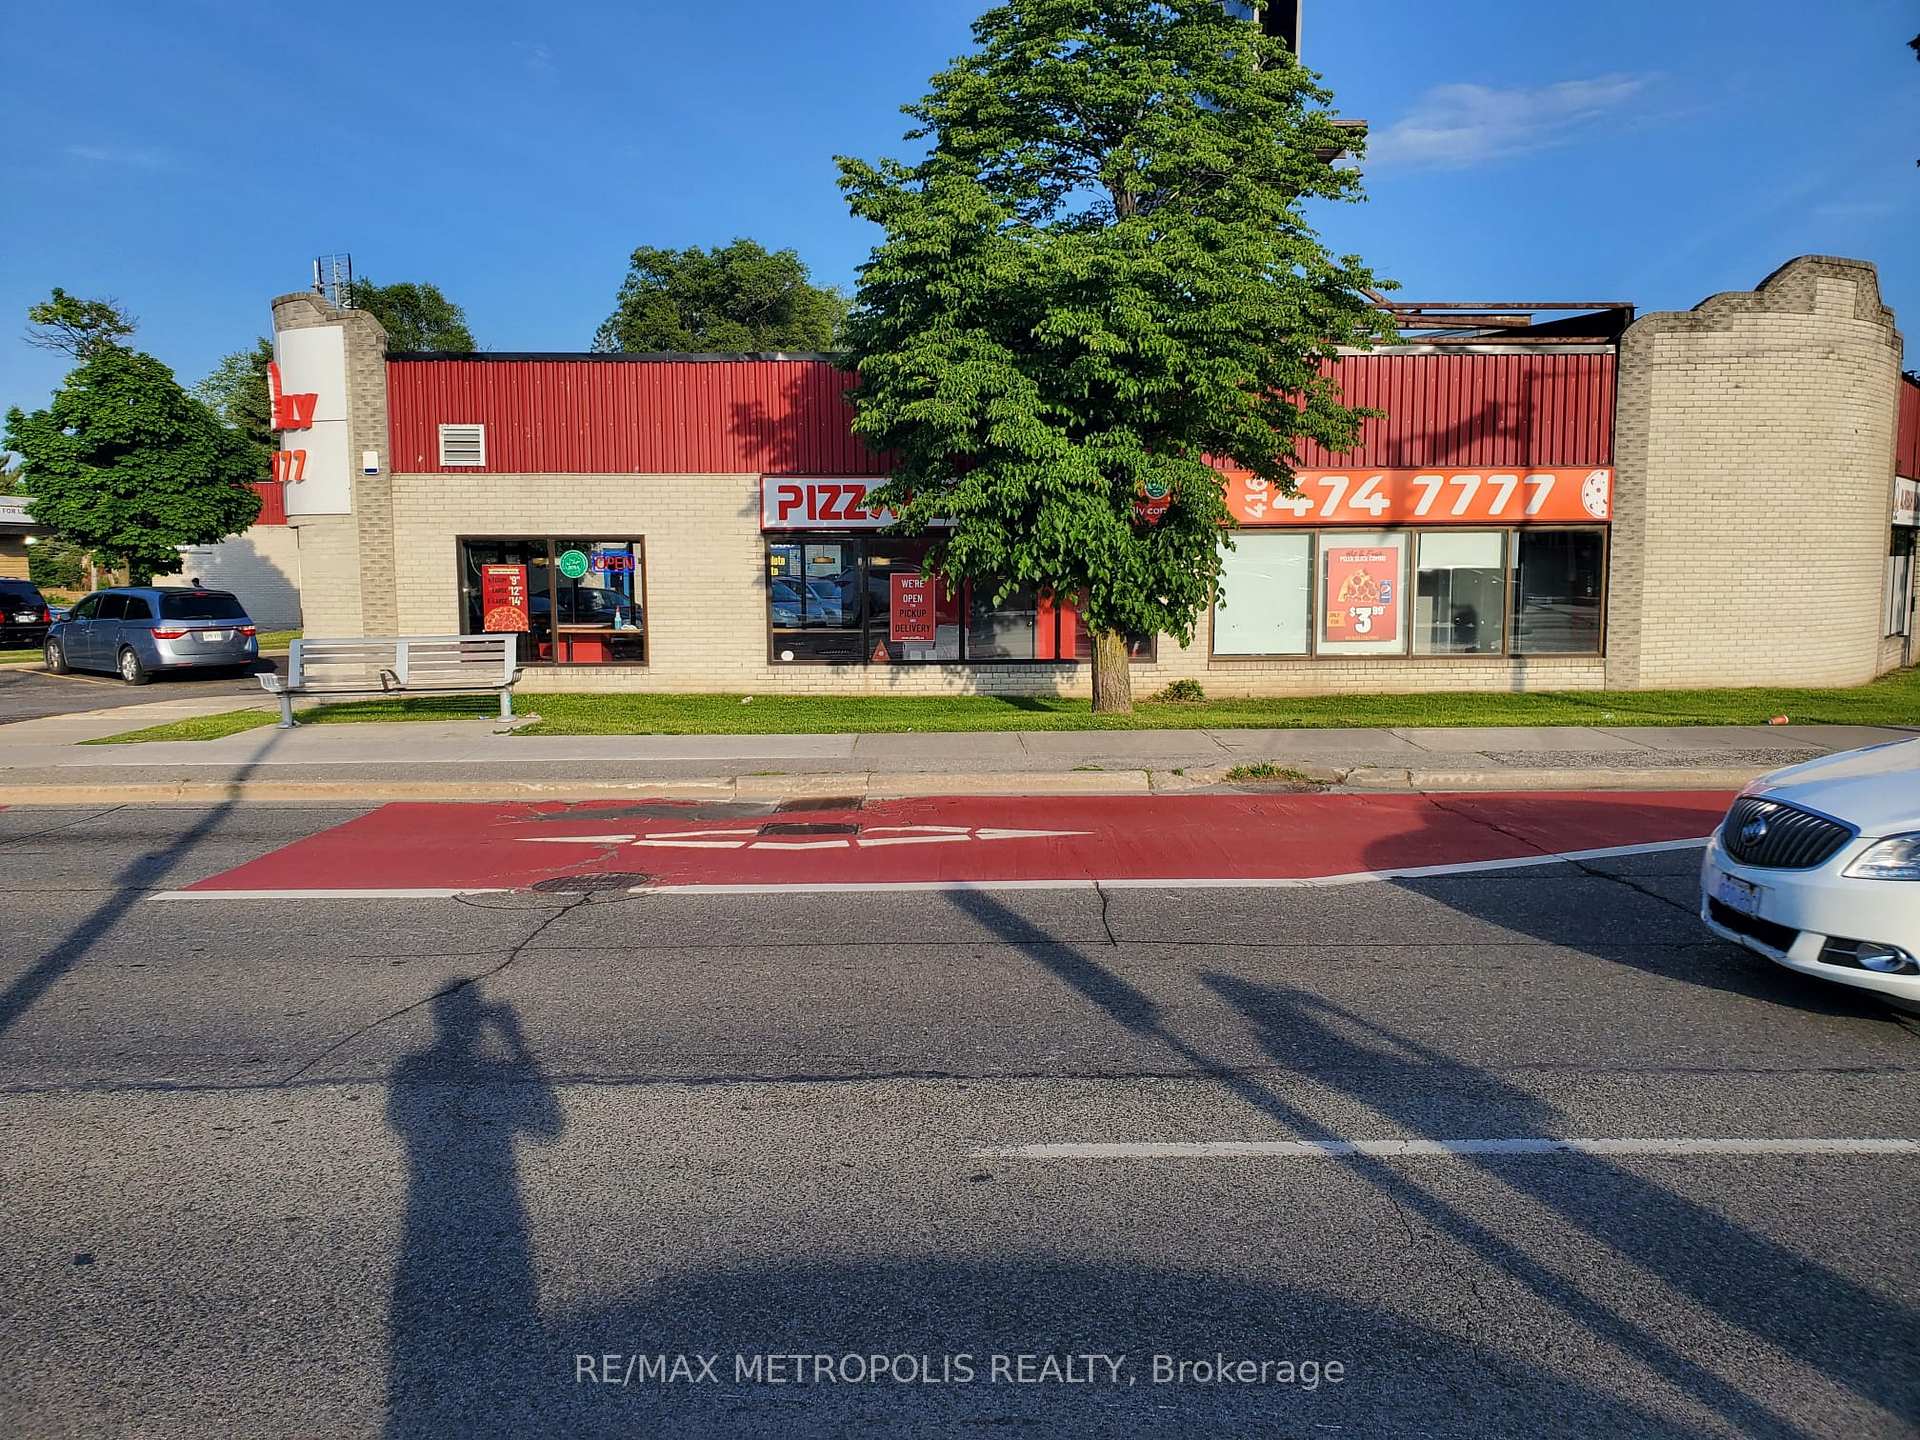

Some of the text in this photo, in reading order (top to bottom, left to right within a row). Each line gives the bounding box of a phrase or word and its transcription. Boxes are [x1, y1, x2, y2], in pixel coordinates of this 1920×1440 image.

[1272, 475, 1391, 517] 474
[1413, 474, 1556, 516] 7777
[594, 556, 635, 570] OPEN
[901, 579, 925, 588] WE'RE
[903, 593, 923, 603] OPEN
[899, 609, 927, 617] PICKUP
[895, 624, 930, 633] DELIVERY
